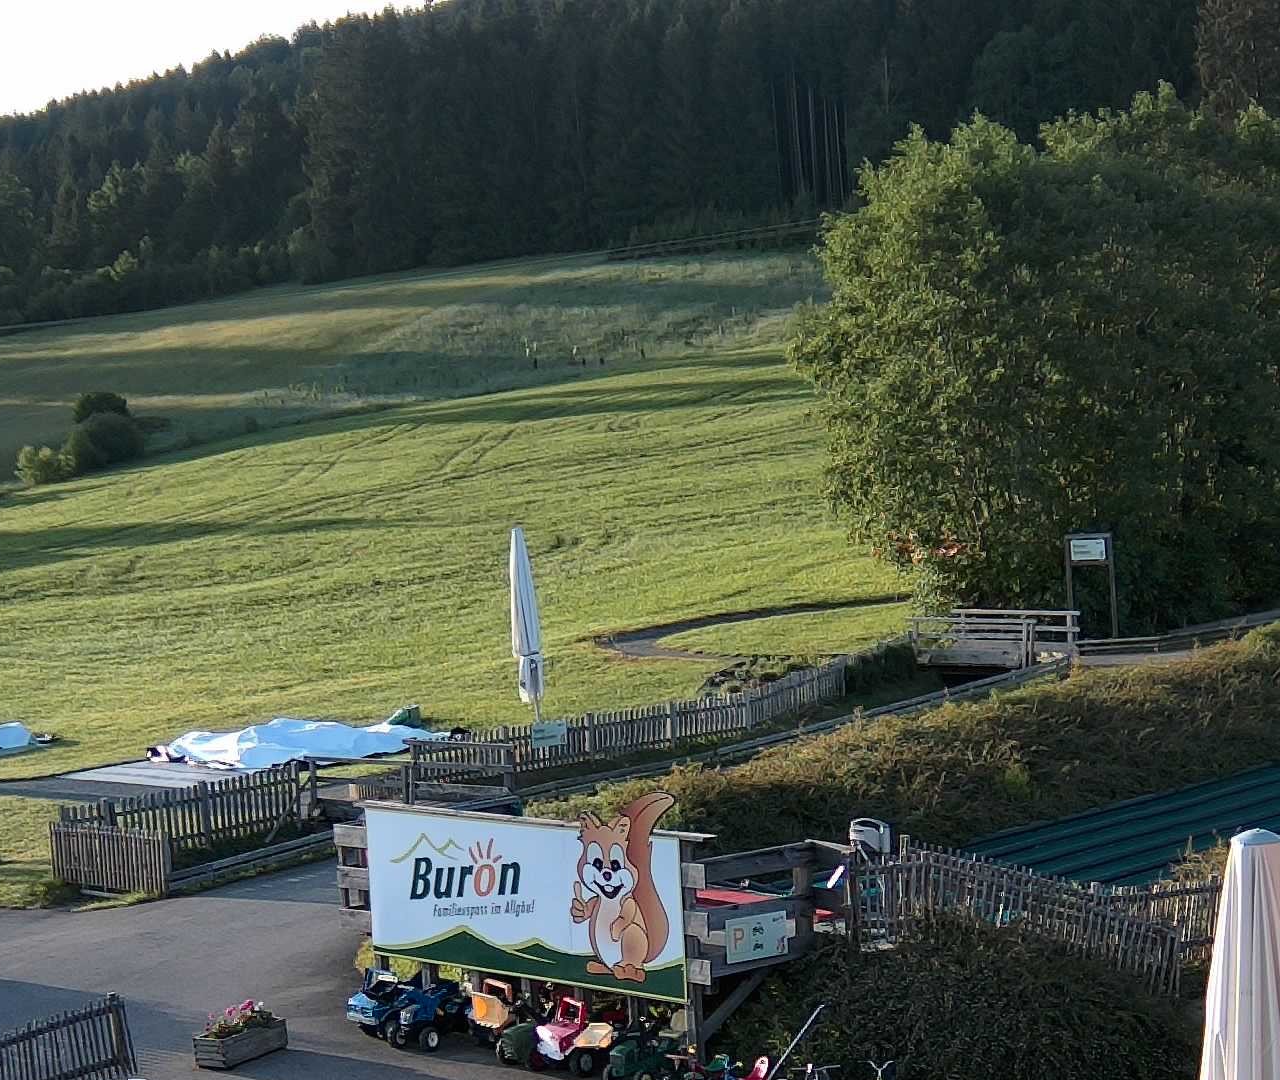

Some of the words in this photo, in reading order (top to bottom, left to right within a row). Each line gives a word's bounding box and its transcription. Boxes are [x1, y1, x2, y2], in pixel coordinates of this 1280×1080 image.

[409, 857, 521, 900] Buron
[491, 902, 501, 915] im
[733, 927, 745, 950] P
